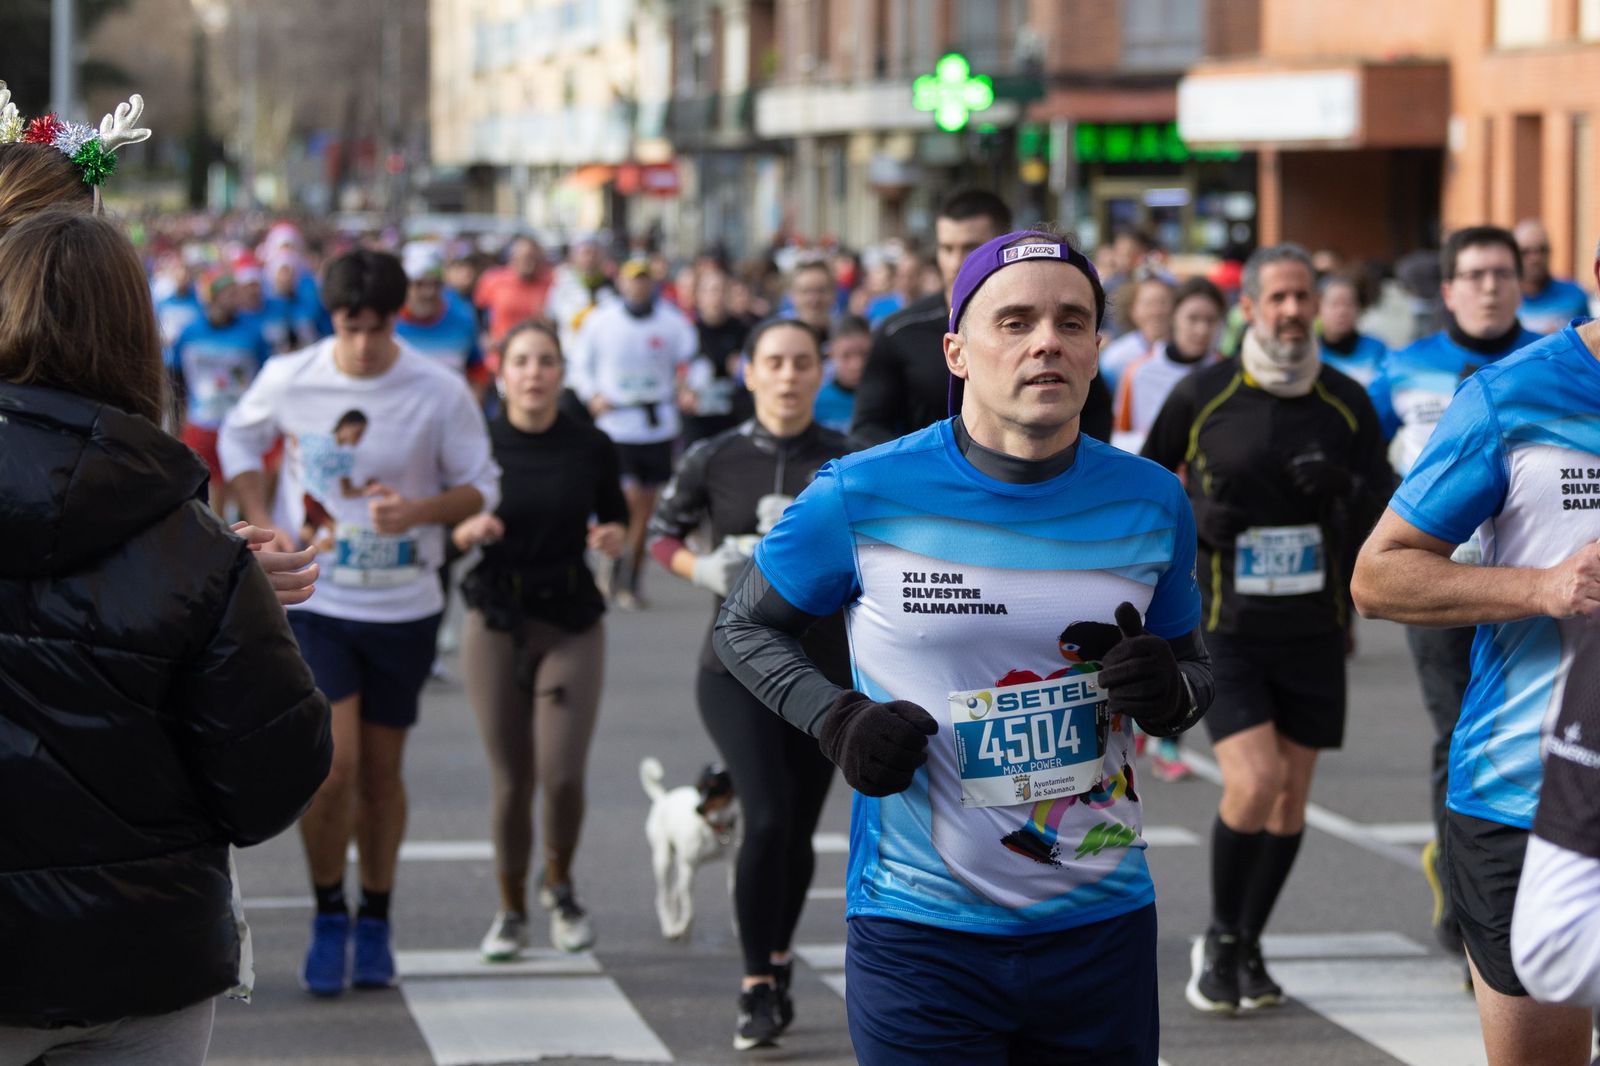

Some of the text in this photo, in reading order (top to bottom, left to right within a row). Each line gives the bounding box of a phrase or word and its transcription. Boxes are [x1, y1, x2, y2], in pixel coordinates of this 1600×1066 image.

[1022, 245, 1056, 257] LAKERS
[1560, 468, 1583, 479] XLI
[1561, 483, 1600, 495] SILVE
[1563, 498, 1600, 510] SALM
[902, 572, 963, 584] XLI SAN
[902, 587, 981, 599] SILVESTRE
[903, 602, 1008, 615] SALMANTINA
[997, 681, 1097, 712] SETEL
[978, 709, 1081, 766] 4504
[1003, 758, 1063, 776] MAX POWER
[1033, 776, 1075, 788] Ayuntamiento
[1043, 785, 1076, 796] Salamanca
